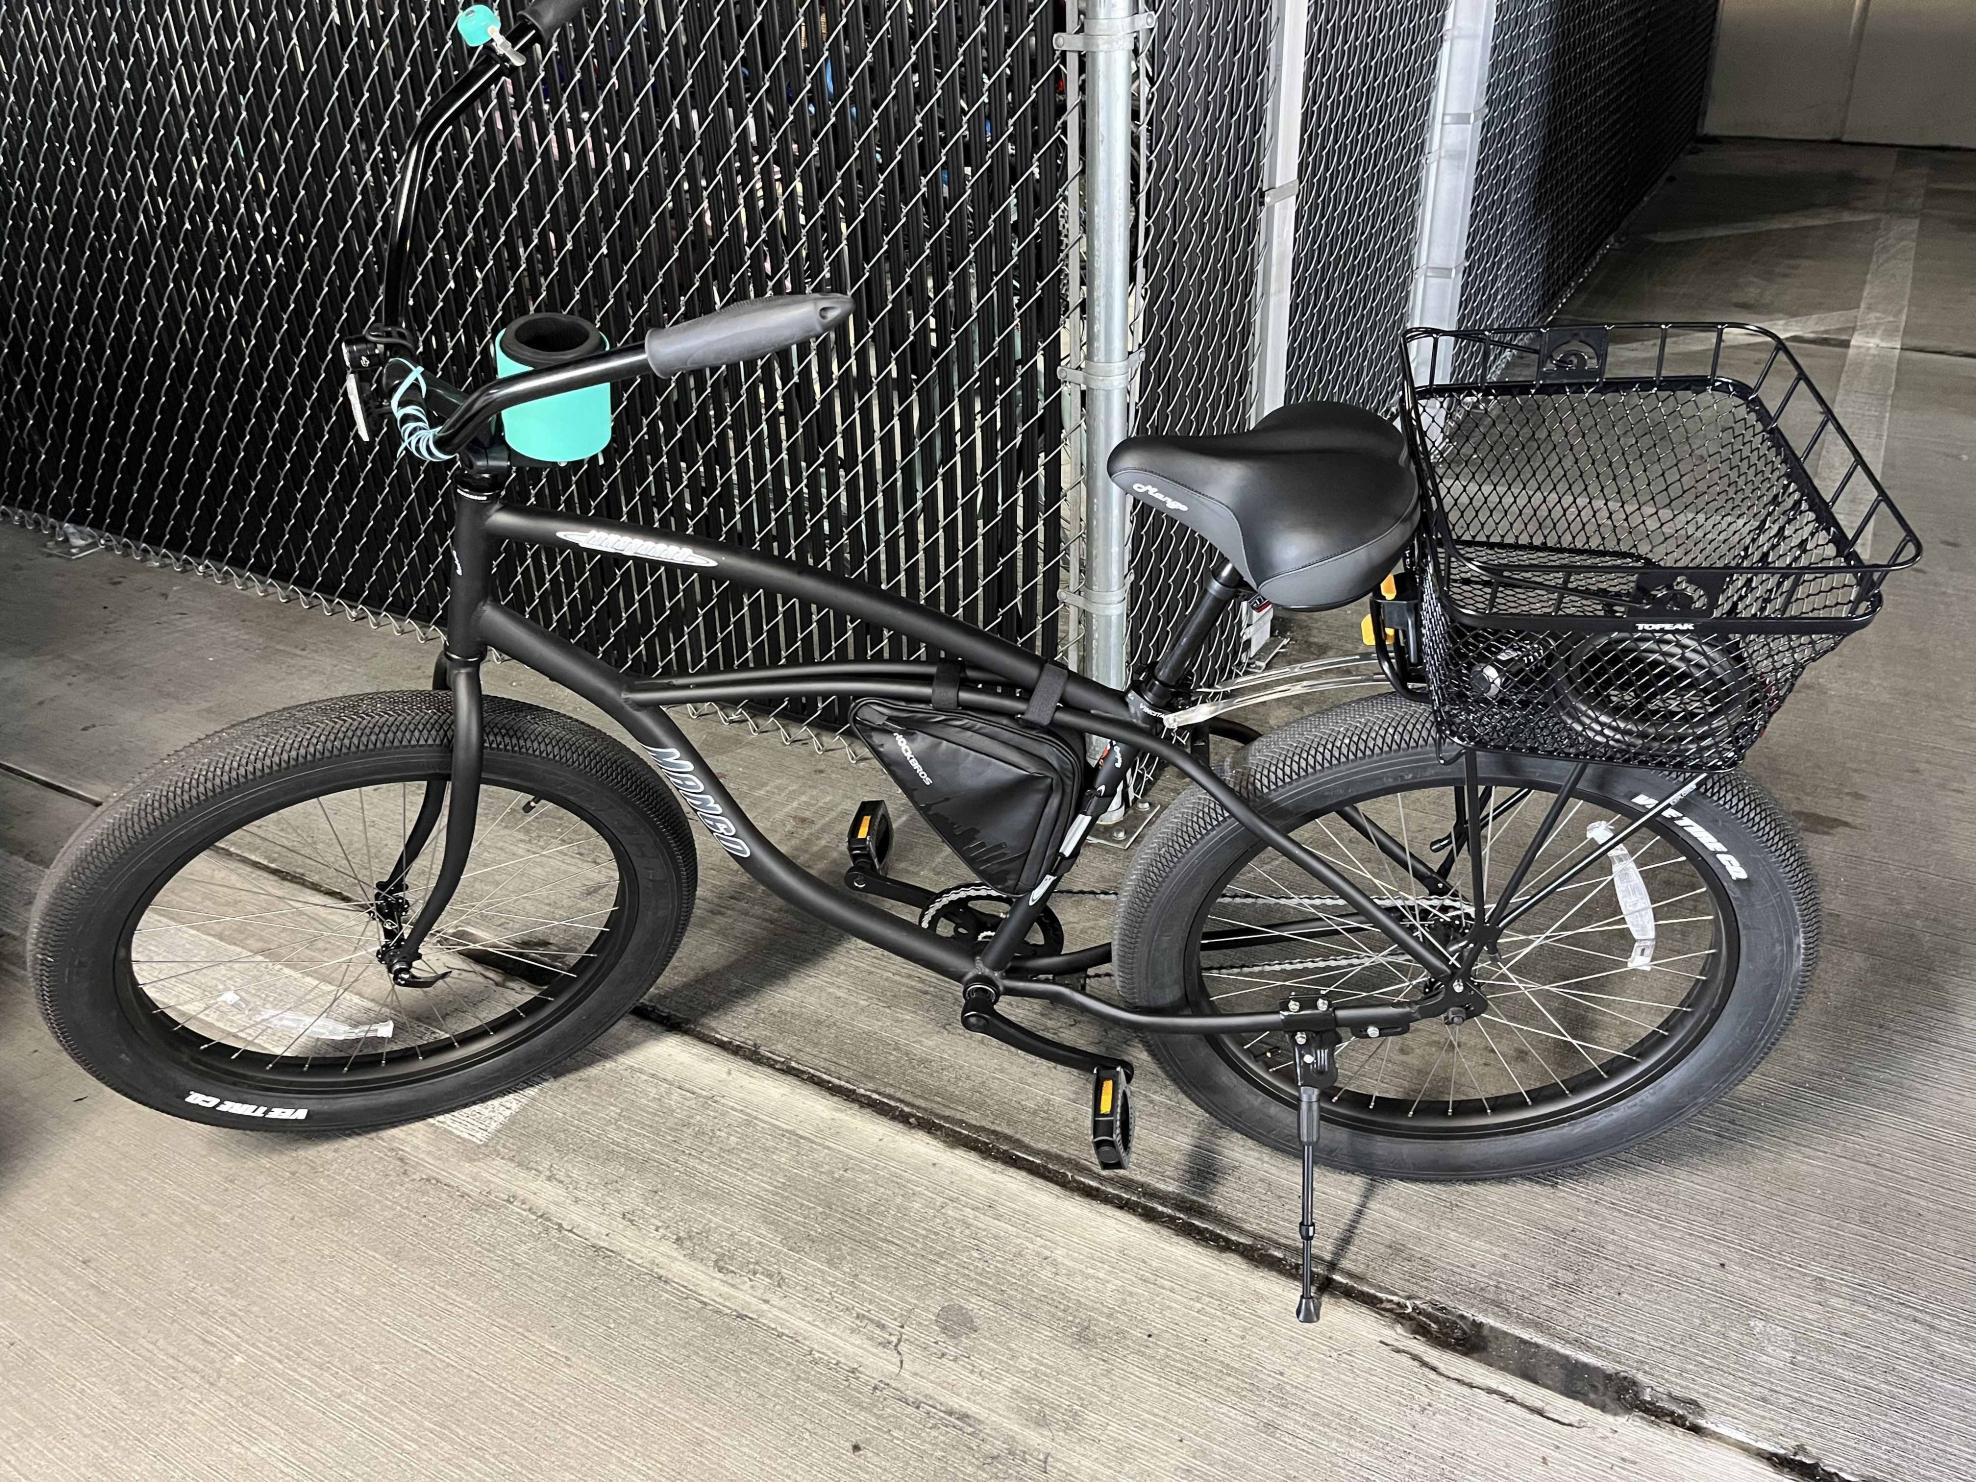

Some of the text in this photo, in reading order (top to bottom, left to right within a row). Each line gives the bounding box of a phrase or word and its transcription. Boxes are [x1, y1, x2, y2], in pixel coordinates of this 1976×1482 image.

[1635, 623, 1695, 631] TOPEAK
[1673, 816, 1728, 852] TIRE
[216, 1101, 268, 1117] TIRE
[264, 1107, 309, 1120] VEE
